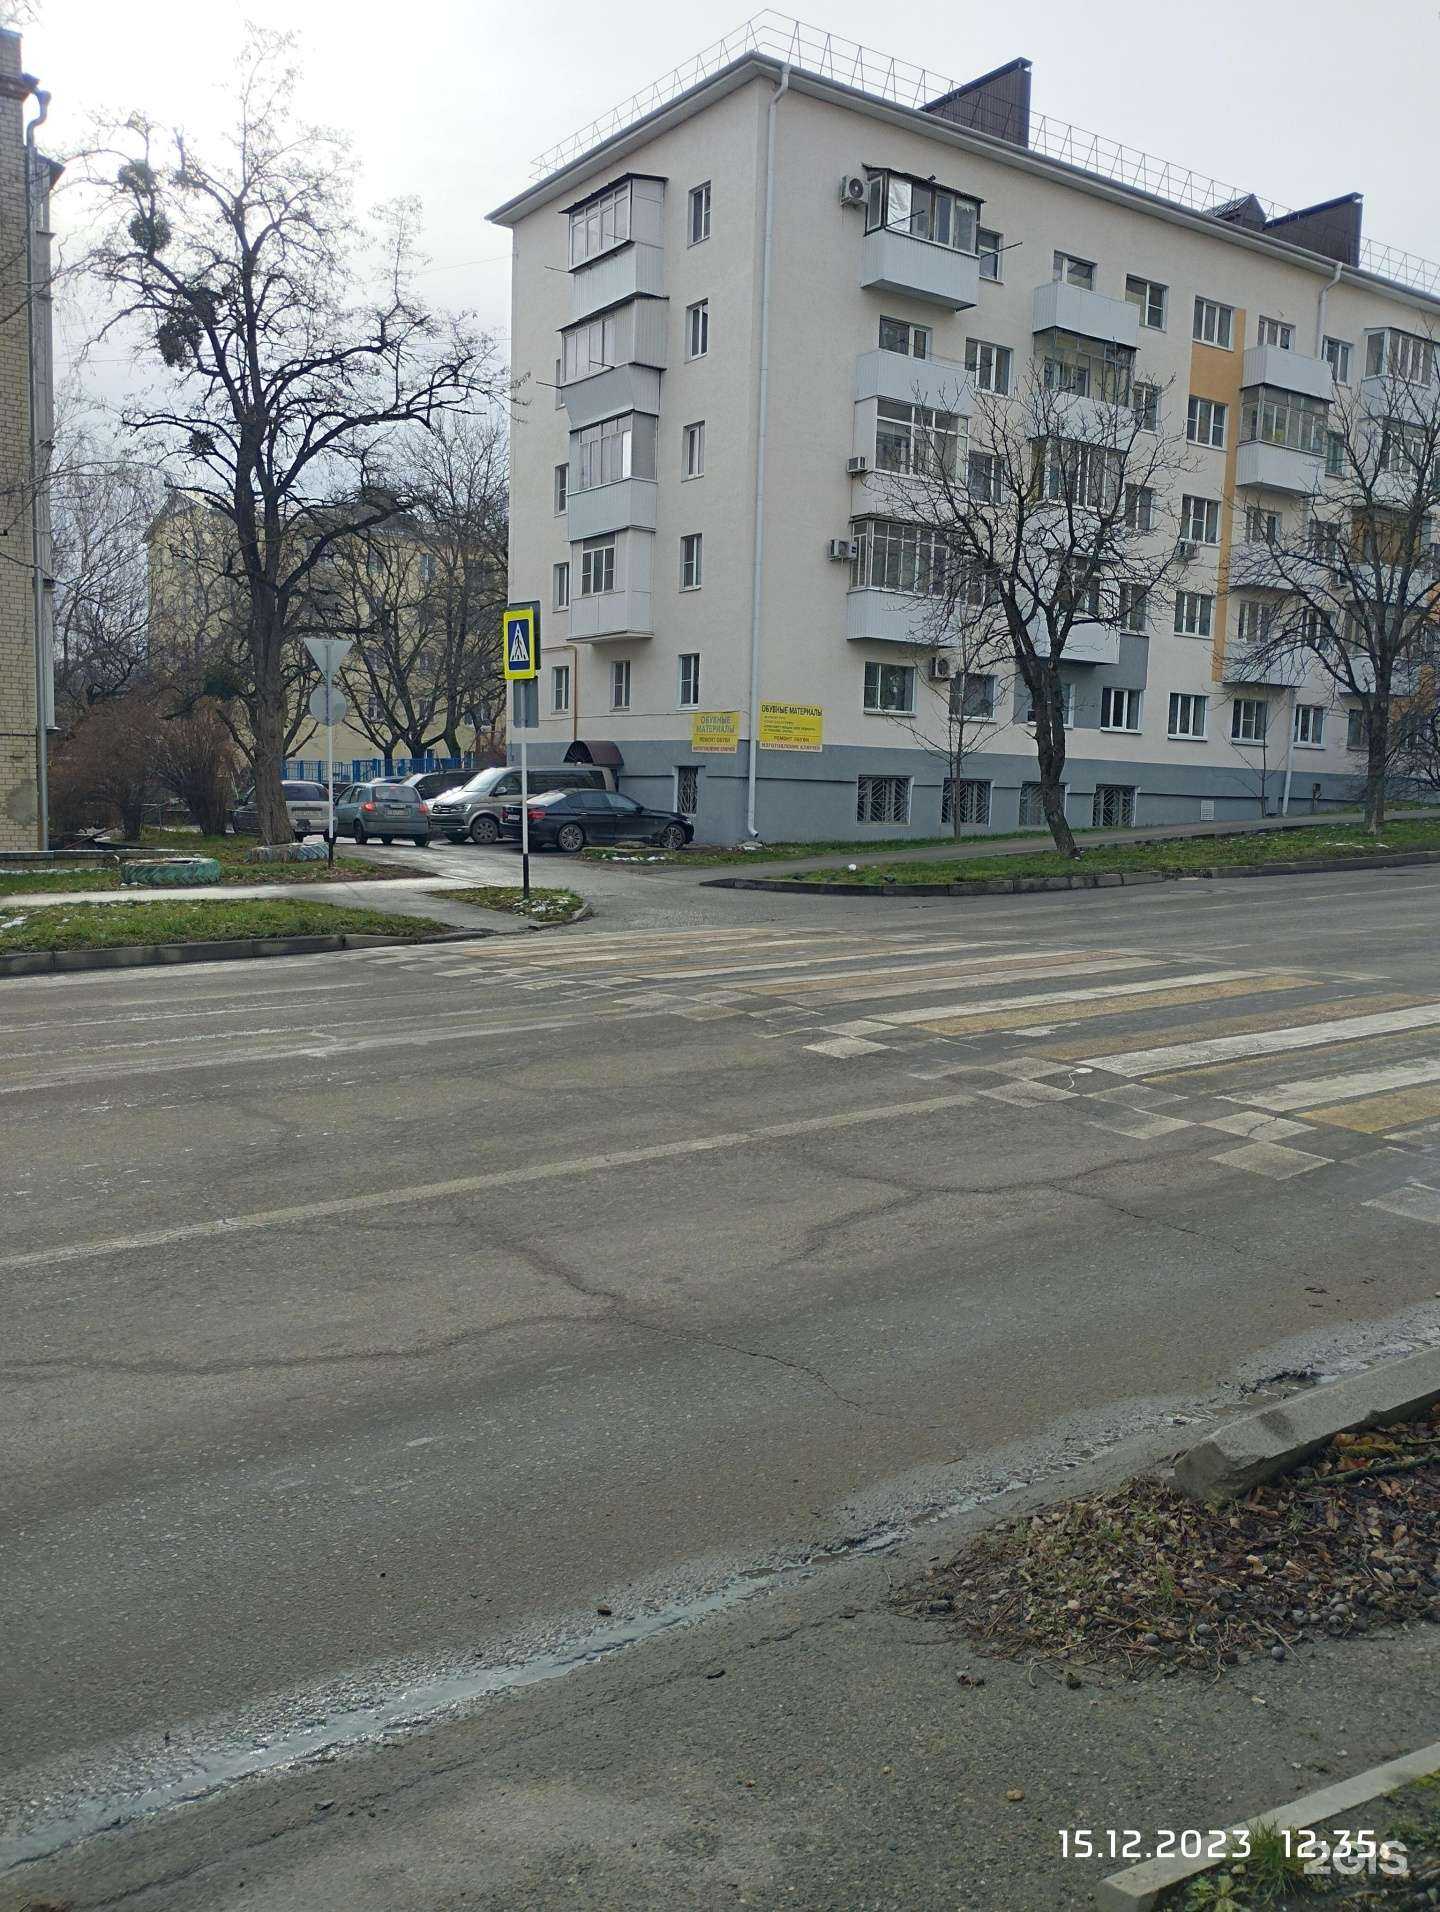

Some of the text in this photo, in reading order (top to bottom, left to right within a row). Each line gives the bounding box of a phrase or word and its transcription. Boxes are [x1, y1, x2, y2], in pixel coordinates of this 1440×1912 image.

[761, 704, 788, 714] ОБУВНЫЕ
[789, 706, 823, 717] МАТЕРИАЛЫ
[700, 715, 732, 724] ОБУВНЫЕ
[696, 725, 735, 733] МАТЕРИАЛЫ
